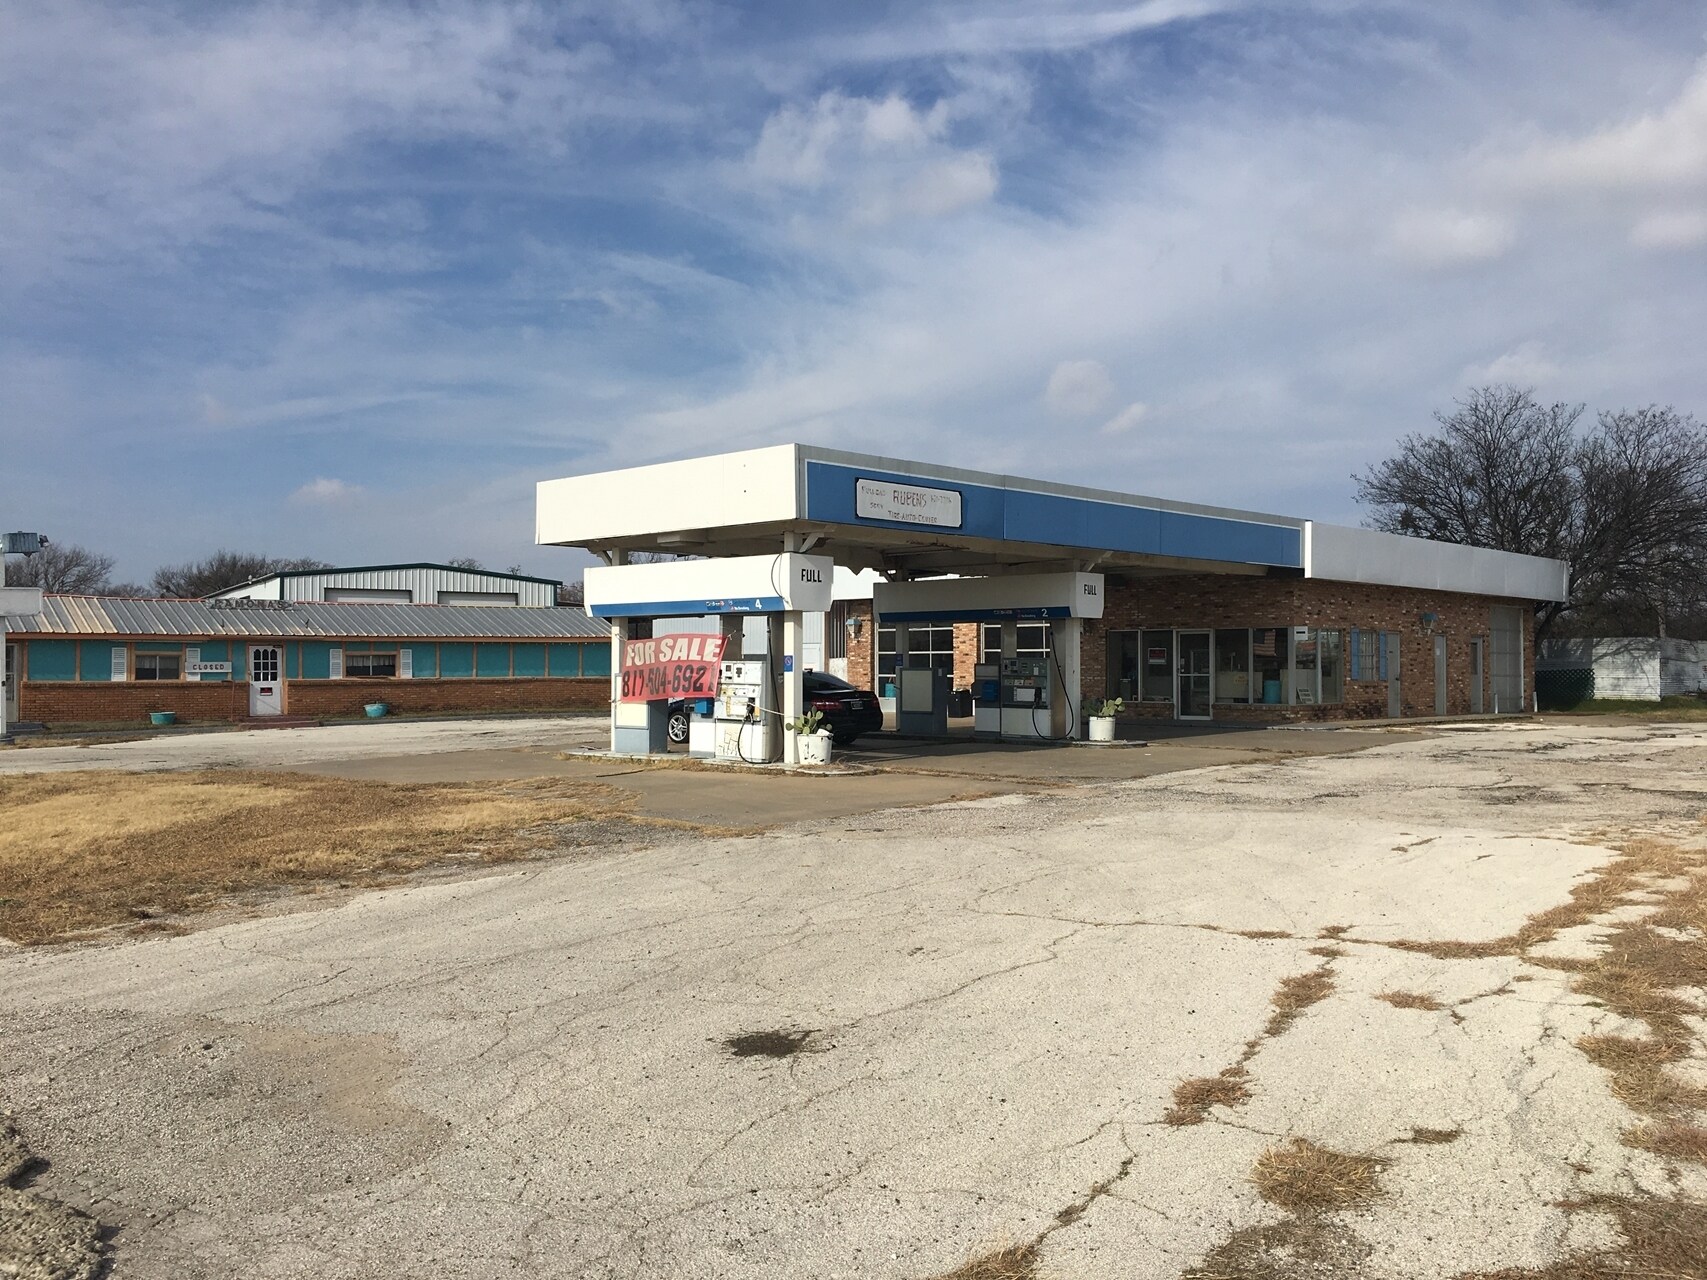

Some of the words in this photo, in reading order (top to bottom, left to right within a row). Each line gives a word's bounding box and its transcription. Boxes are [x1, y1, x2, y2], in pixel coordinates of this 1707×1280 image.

[801, 568, 822, 583] FULL
[1083, 583, 1097, 596] FULL
[755, 599, 762, 609] 4
[1041, 608, 1048, 617] 2
[625, 641, 656, 667] FOR
[659, 638, 722, 663] SALE
